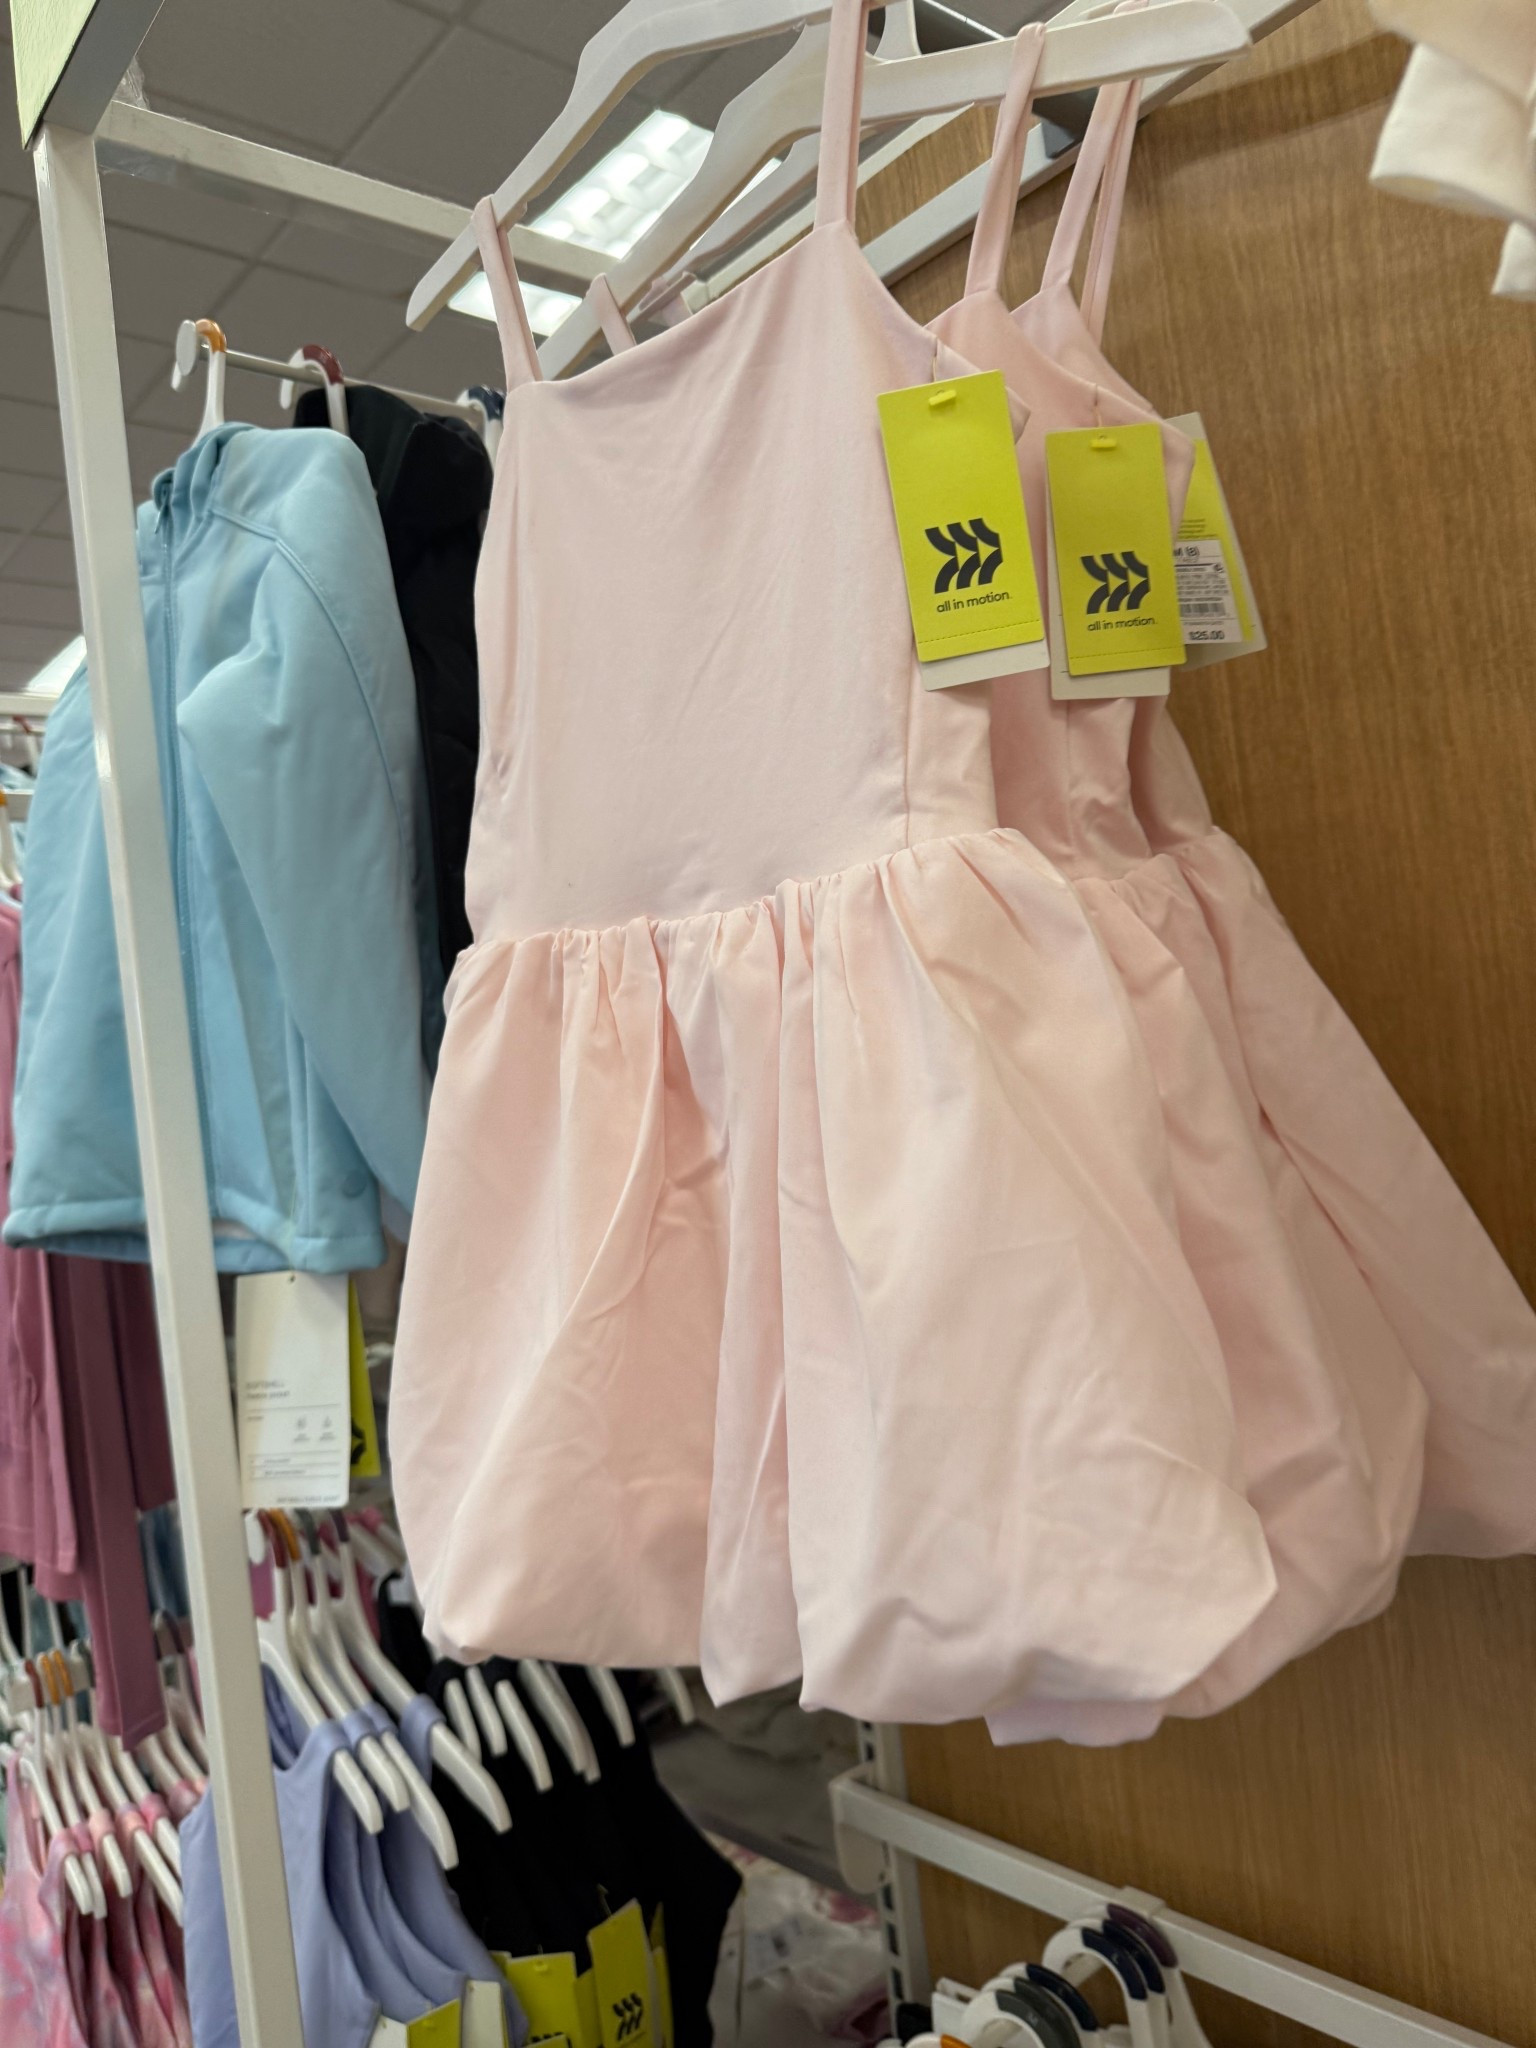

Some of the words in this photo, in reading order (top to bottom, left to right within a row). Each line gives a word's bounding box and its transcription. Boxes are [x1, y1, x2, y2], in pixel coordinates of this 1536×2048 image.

[937, 601, 951, 613] all
[953, 598, 965, 610] in
[967, 591, 1010, 607] motion
[1087, 620, 1101, 632] all
[1103, 619, 1113, 630] in
[1115, 616, 1155, 629] motion
